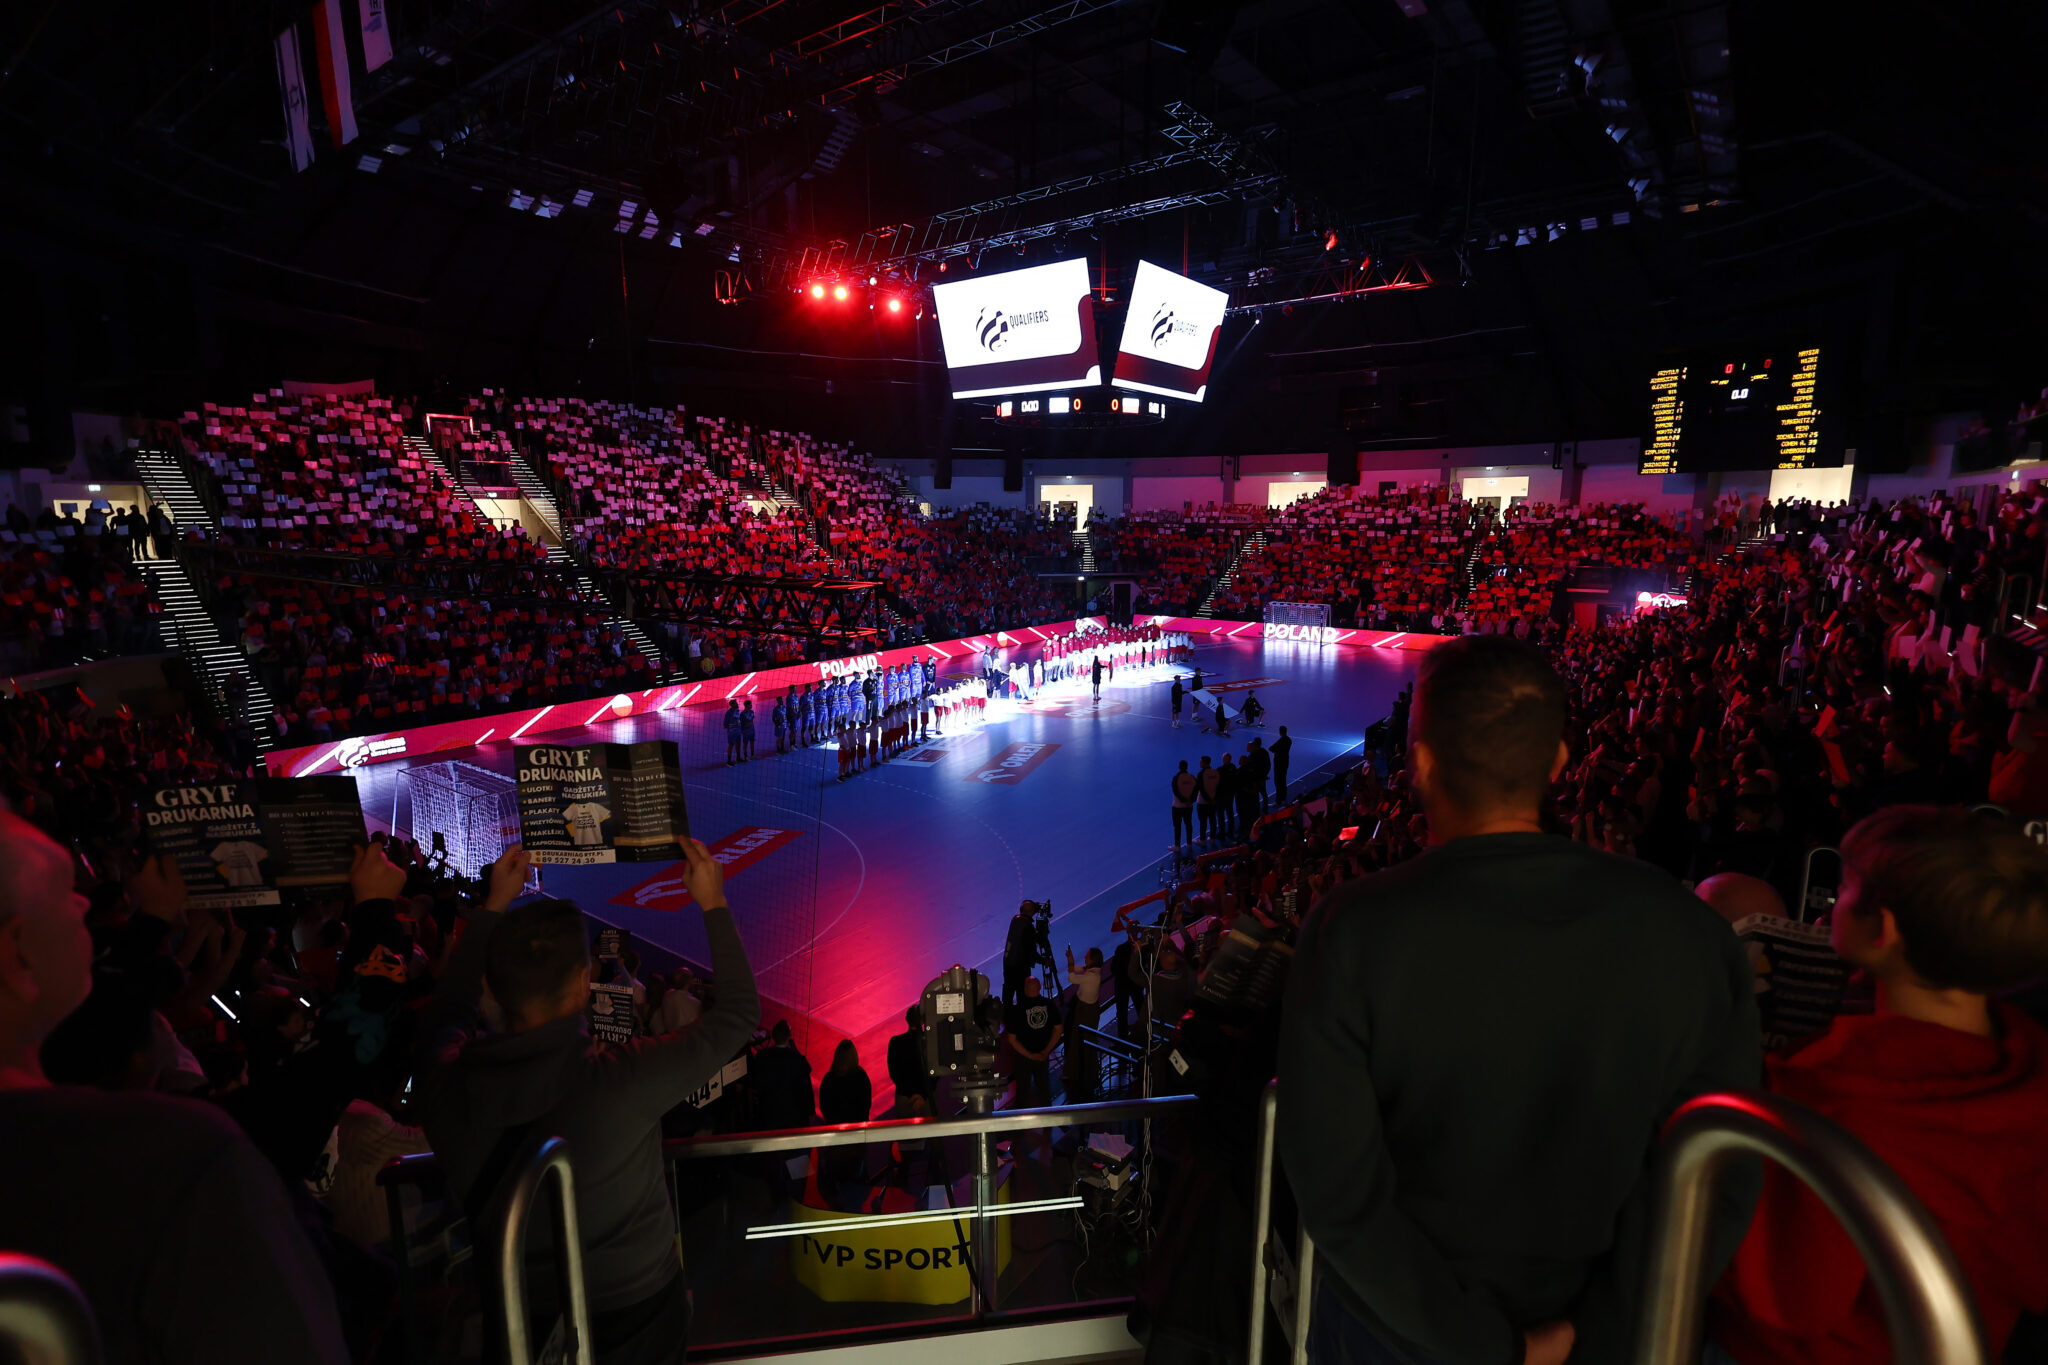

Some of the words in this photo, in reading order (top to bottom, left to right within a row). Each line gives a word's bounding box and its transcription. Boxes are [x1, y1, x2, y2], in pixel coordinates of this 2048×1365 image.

[1009, 310, 1049, 328] QUALIFIERS
[1724, 363, 1734, 374] 0
[1073, 398, 1081, 411] 0
[1111, 398, 1119, 411] 0
[1264, 623, 1337, 643] POLAND
[820, 655, 878, 679] POLAND
[529, 748, 591, 767] GRYF
[1000, 743, 1046, 768] ORLEN
[519, 767, 603, 783] DRUKARNIA
[154, 784, 238, 808] GRYF
[526, 785, 553, 793] ULOTKI
[561, 790, 607, 800] NADRUKIEM
[527, 796, 557, 805] BANERY
[146, 803, 255, 827] DRUKARNIA
[528, 807, 561, 815] PLAKATY
[530, 828, 565, 837] NAKLEJKI
[802, 1234, 855, 1267] TVP
[864, 1241, 971, 1270] SPORT
